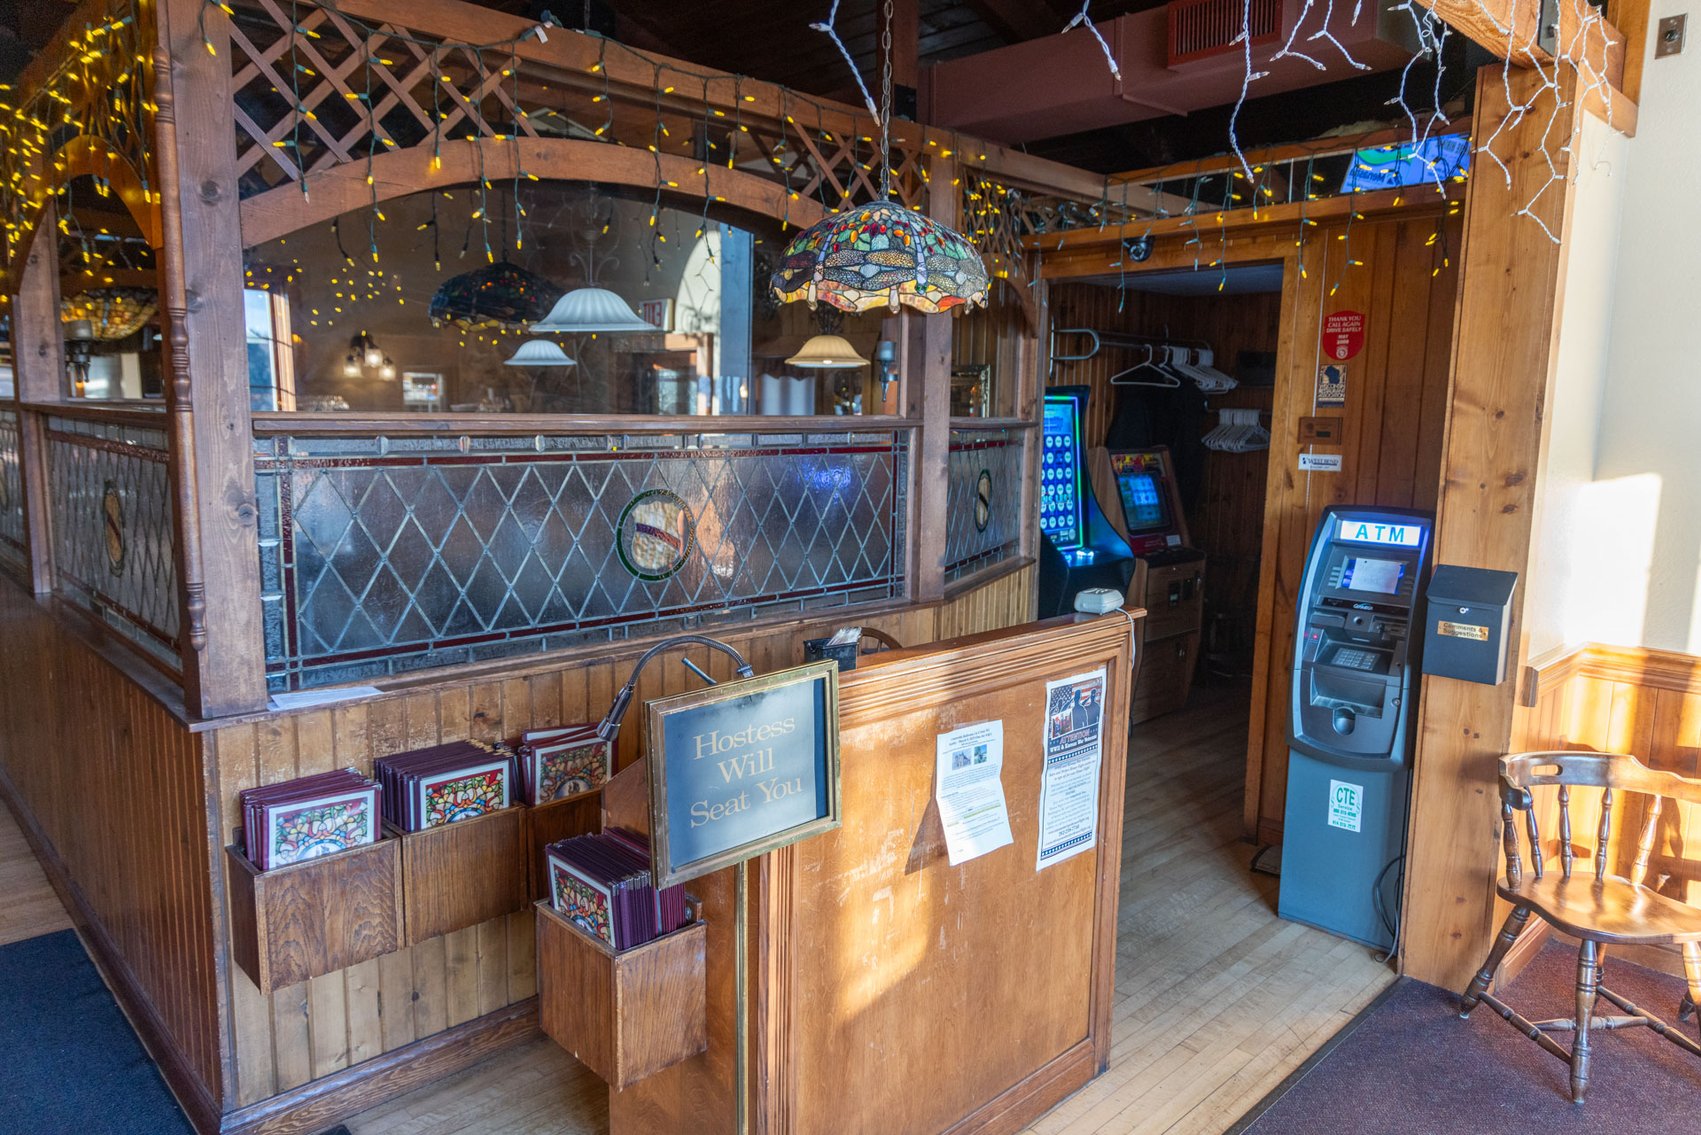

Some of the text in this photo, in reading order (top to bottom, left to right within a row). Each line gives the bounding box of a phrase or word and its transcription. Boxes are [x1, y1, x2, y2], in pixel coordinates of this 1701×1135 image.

[1355, 524, 1405, 543] ATM
[1443, 622, 1477, 632] Comments
[1443, 628, 1483, 639] Suggestions
[693, 717, 796, 760] Hostess
[1060, 728, 1090, 744] ATTENTION
[717, 748, 776, 784] Will
[690, 777, 802, 829] Seat You
[1336, 787, 1356, 806] CTE
